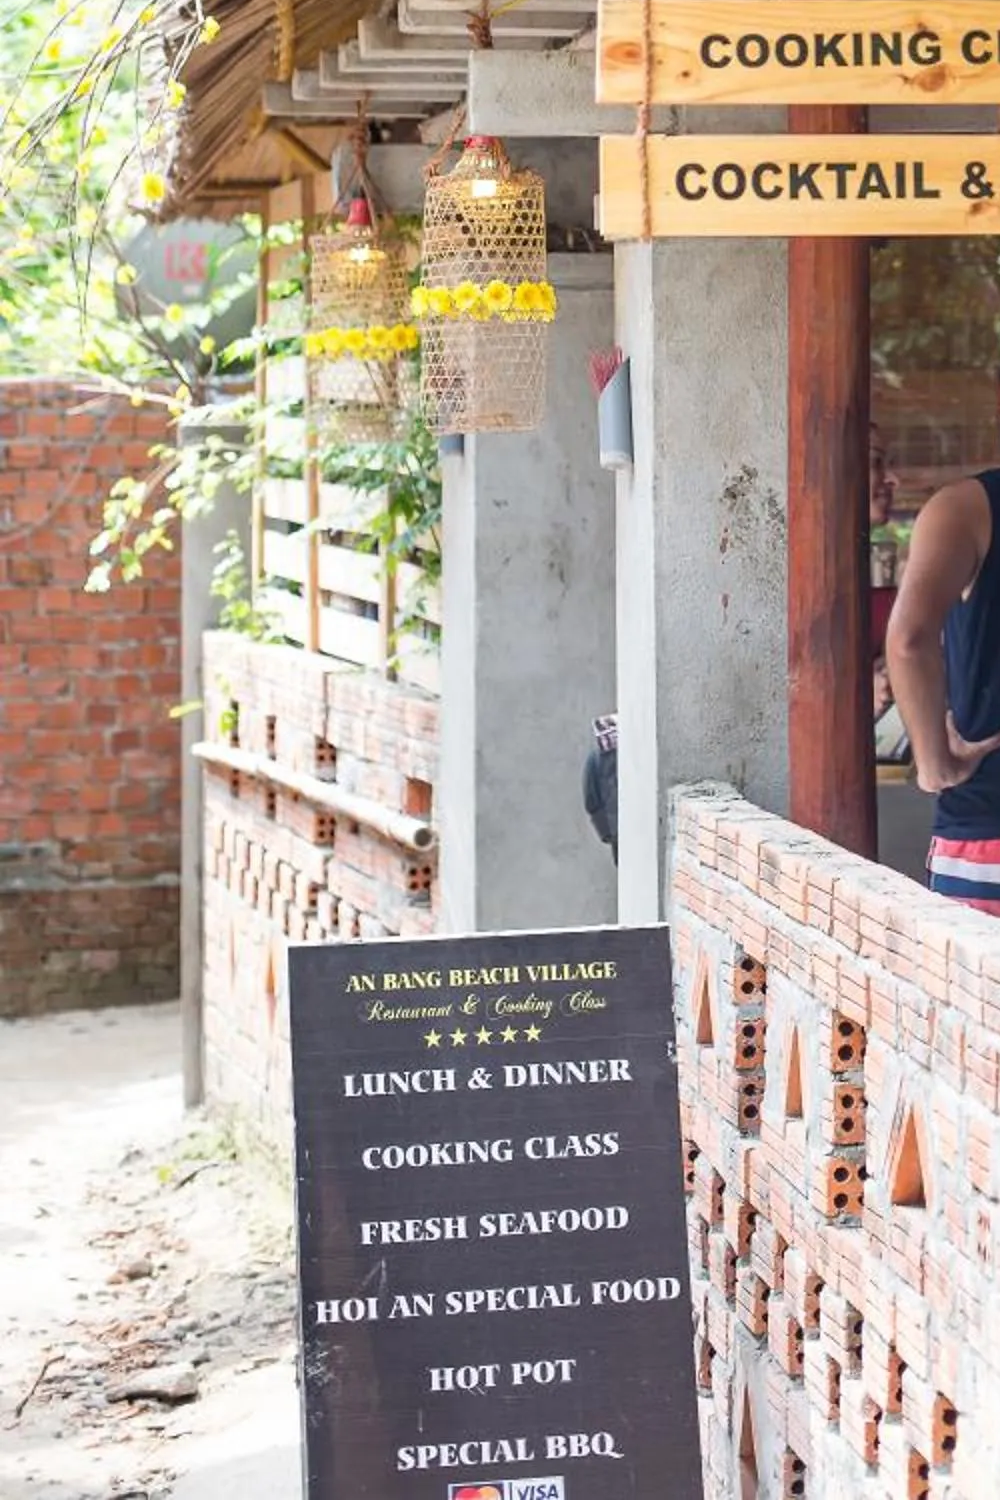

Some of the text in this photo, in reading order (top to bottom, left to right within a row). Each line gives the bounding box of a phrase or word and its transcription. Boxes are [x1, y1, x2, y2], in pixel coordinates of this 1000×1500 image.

[700, 32, 942, 69] COOKING
[675, 161, 941, 201] COCKTAIL
[960, 161, 996, 201] &
[345, 961, 618, 993] AN BANG BEACH VILLAGE
[364, 989, 607, 1022] Restaurant & Cooking Class
[343, 1058, 633, 1097] LUNCH & DINNER
[361, 1131, 620, 1170] COOKING CLASS
[360, 1205, 629, 1245] FRESH SEAFOOD
[315, 1277, 681, 1324] HOI AN SPECIAL FOOD
[429, 1358, 577, 1391] HOT POT
[397, 1431, 625, 1471] SPECIAL BBQ
[517, 1484, 559, 1500] VISA
